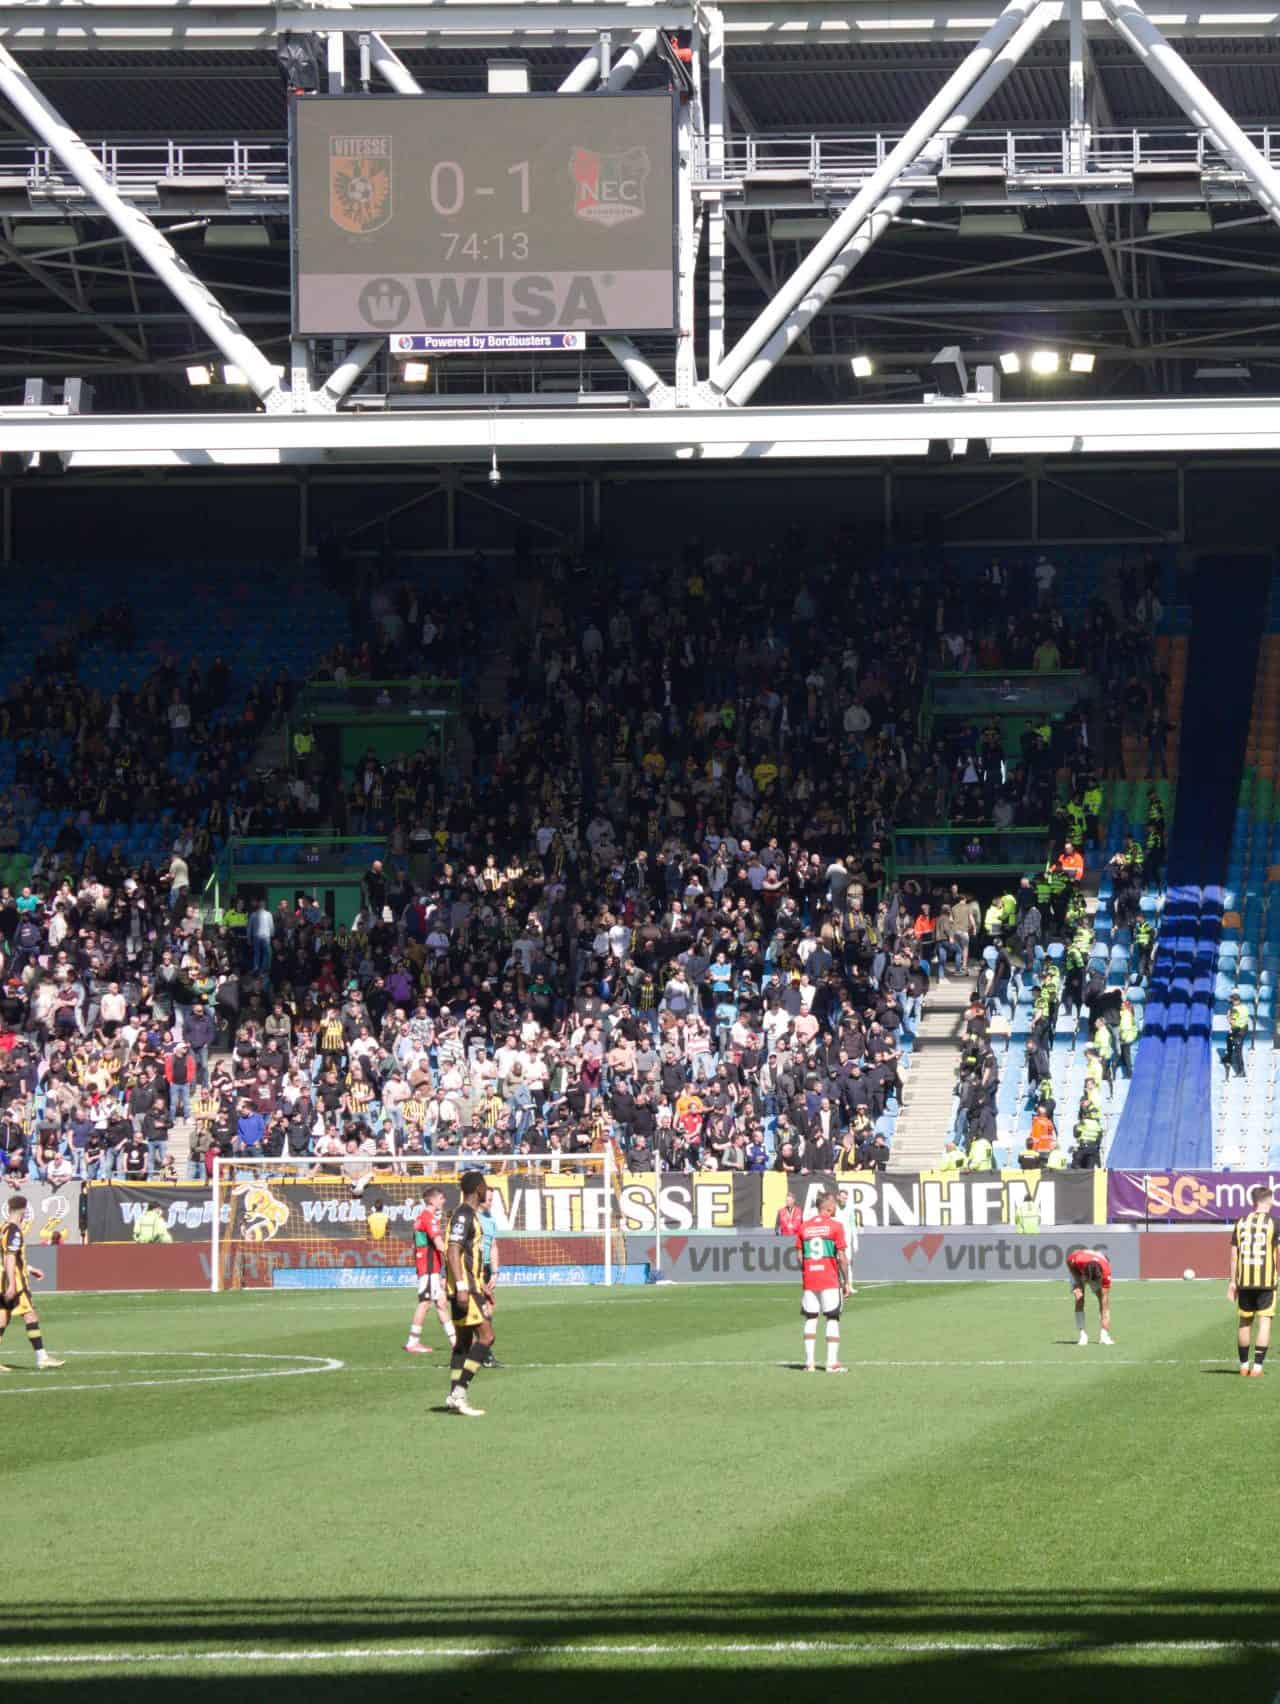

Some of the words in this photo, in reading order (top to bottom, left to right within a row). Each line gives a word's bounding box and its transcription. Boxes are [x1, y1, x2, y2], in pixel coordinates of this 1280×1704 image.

[439, 231, 529, 261] 74:13
[415, 275, 607, 328] WISA
[425, 336, 471, 348] Powered
[473, 336, 485, 349] by
[488, 336, 551, 347] Bordbusters
[301, 1199, 367, 1223] With
[490, 1185, 731, 1232] VITESSE
[802, 1182, 1056, 1227] ARNHEM
[689, 1241, 803, 1272] virtuo
[810, 1237, 824, 1259] 9
[944, 1239, 1109, 1270] virtuo
[1240, 1231, 1266, 1255] 22
